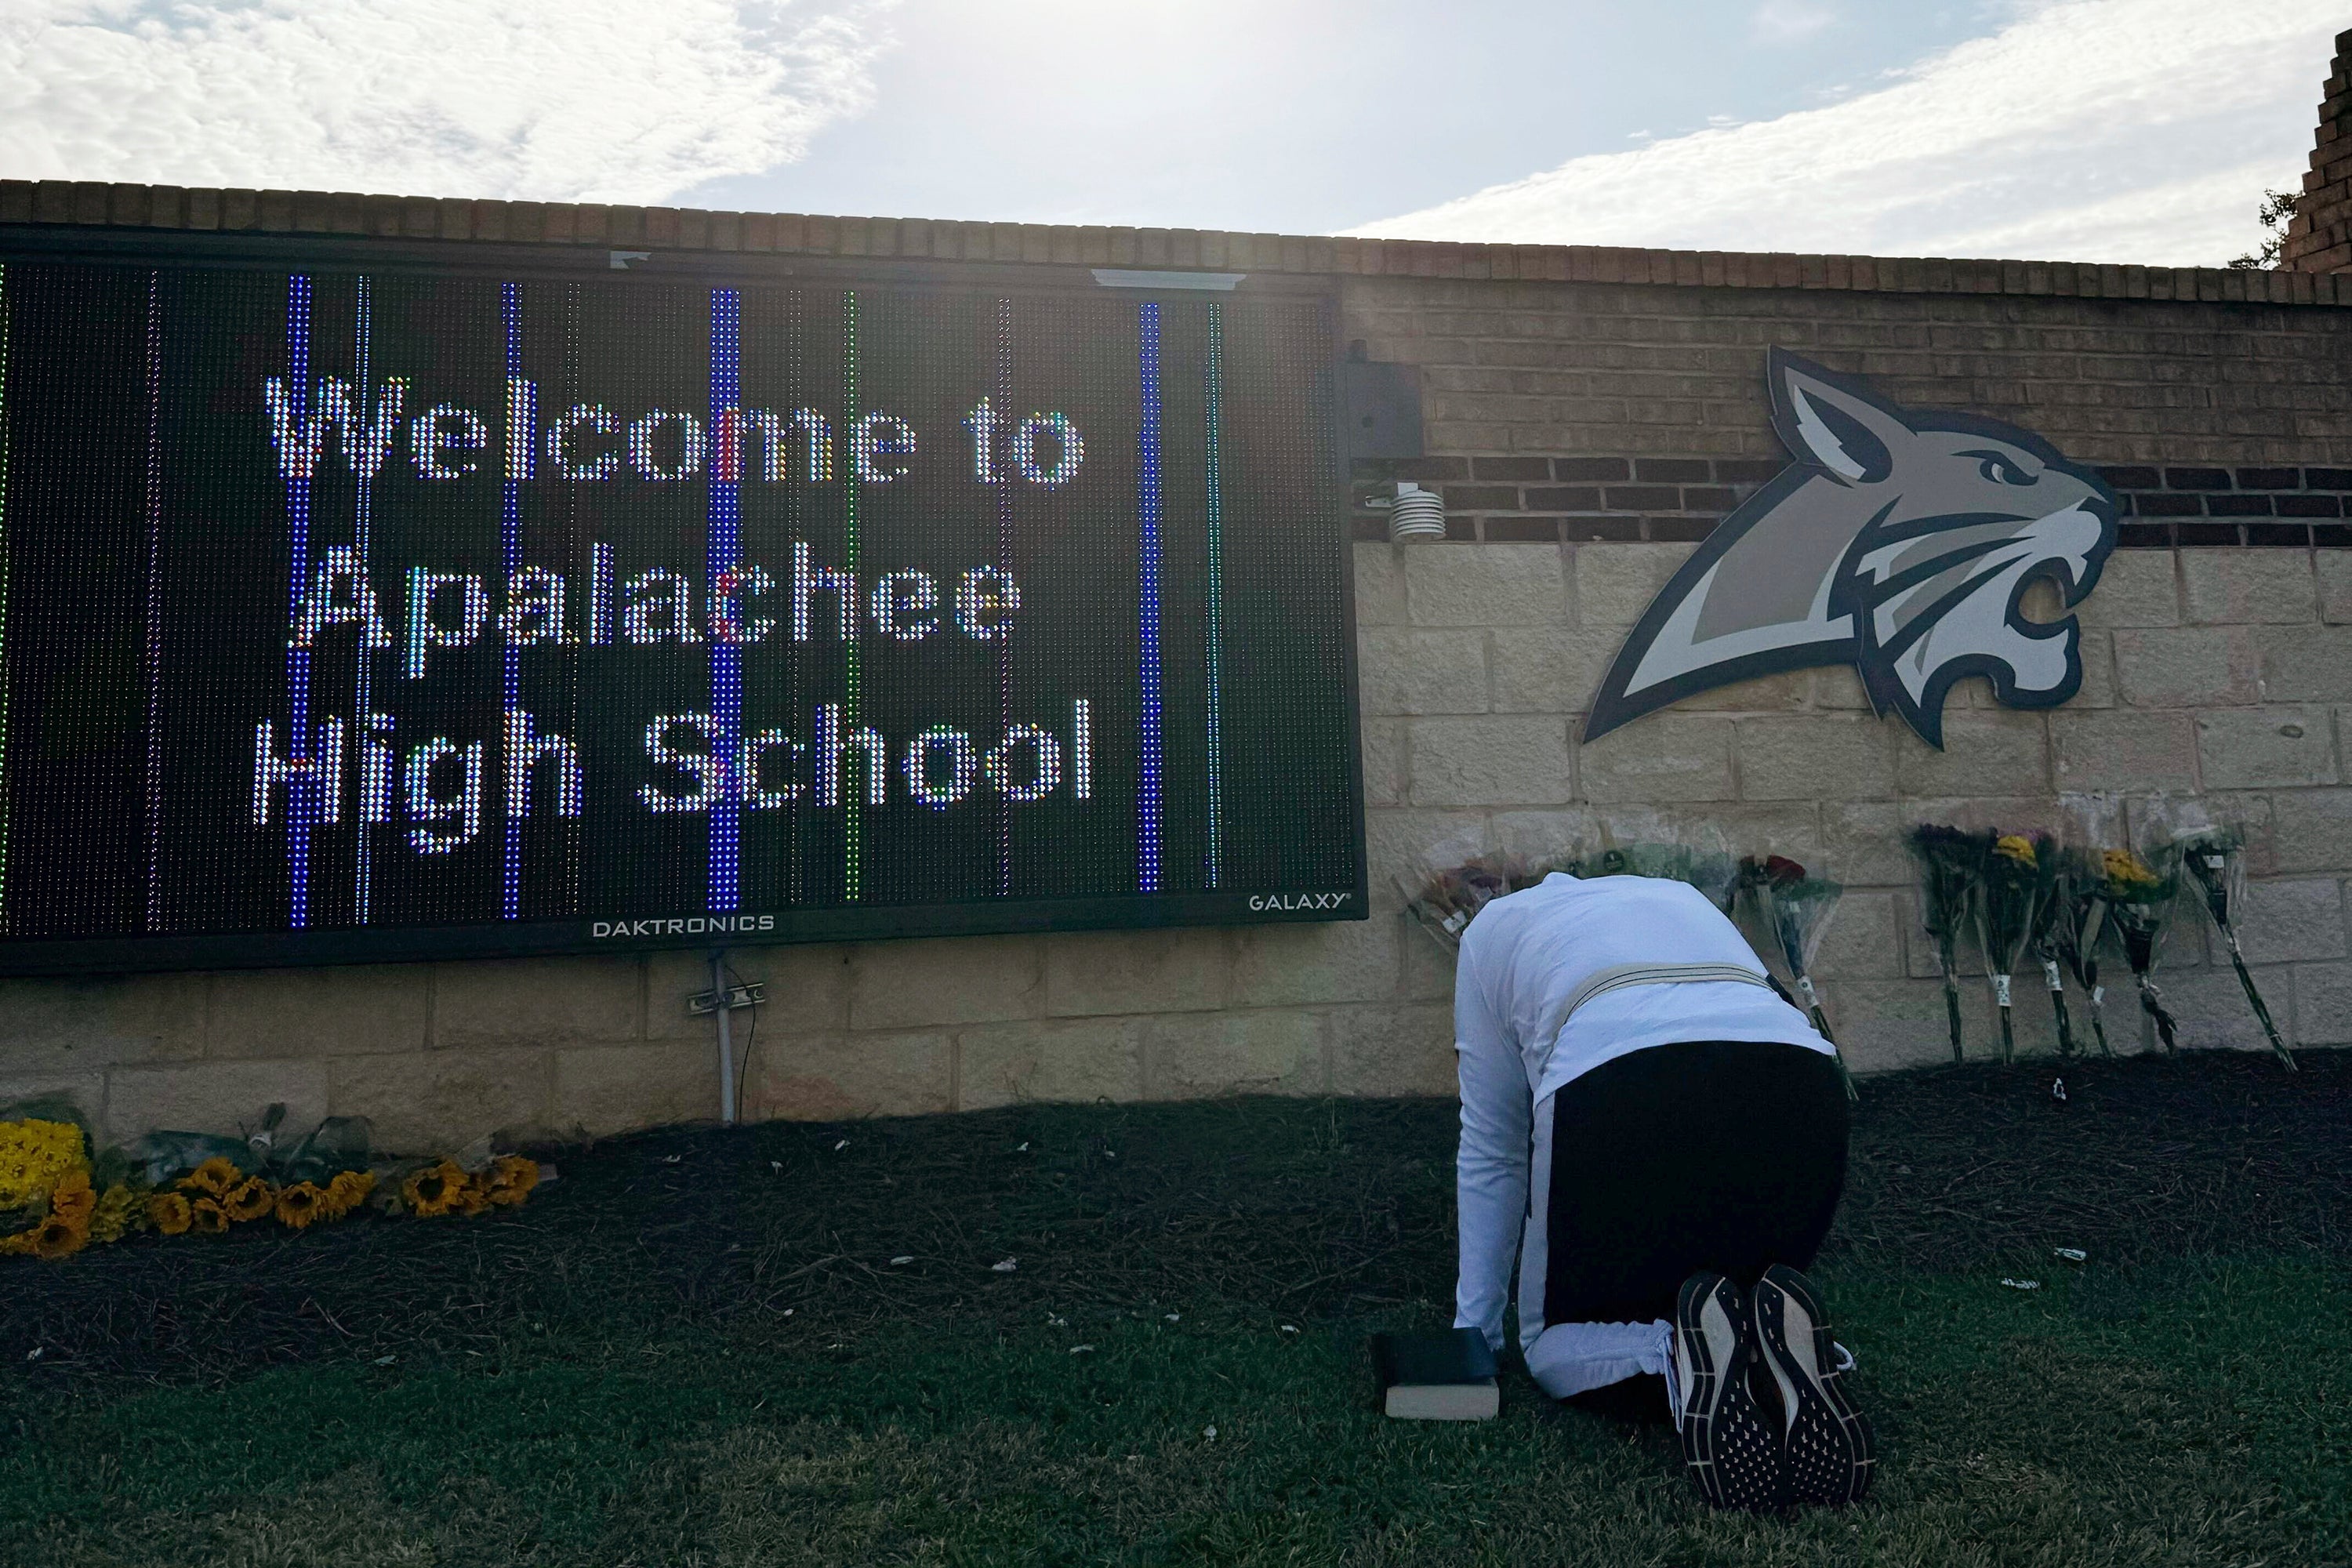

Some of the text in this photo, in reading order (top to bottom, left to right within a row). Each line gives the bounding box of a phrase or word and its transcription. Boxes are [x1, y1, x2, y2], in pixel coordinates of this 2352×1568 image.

[264, 375, 1085, 491] Welcome to
[287, 542, 1022, 679] Apalachee
[253, 699, 1091, 854] High School
[593, 915, 775, 938] DAKTRONICS
[1249, 892, 1346, 911] GALAXY
